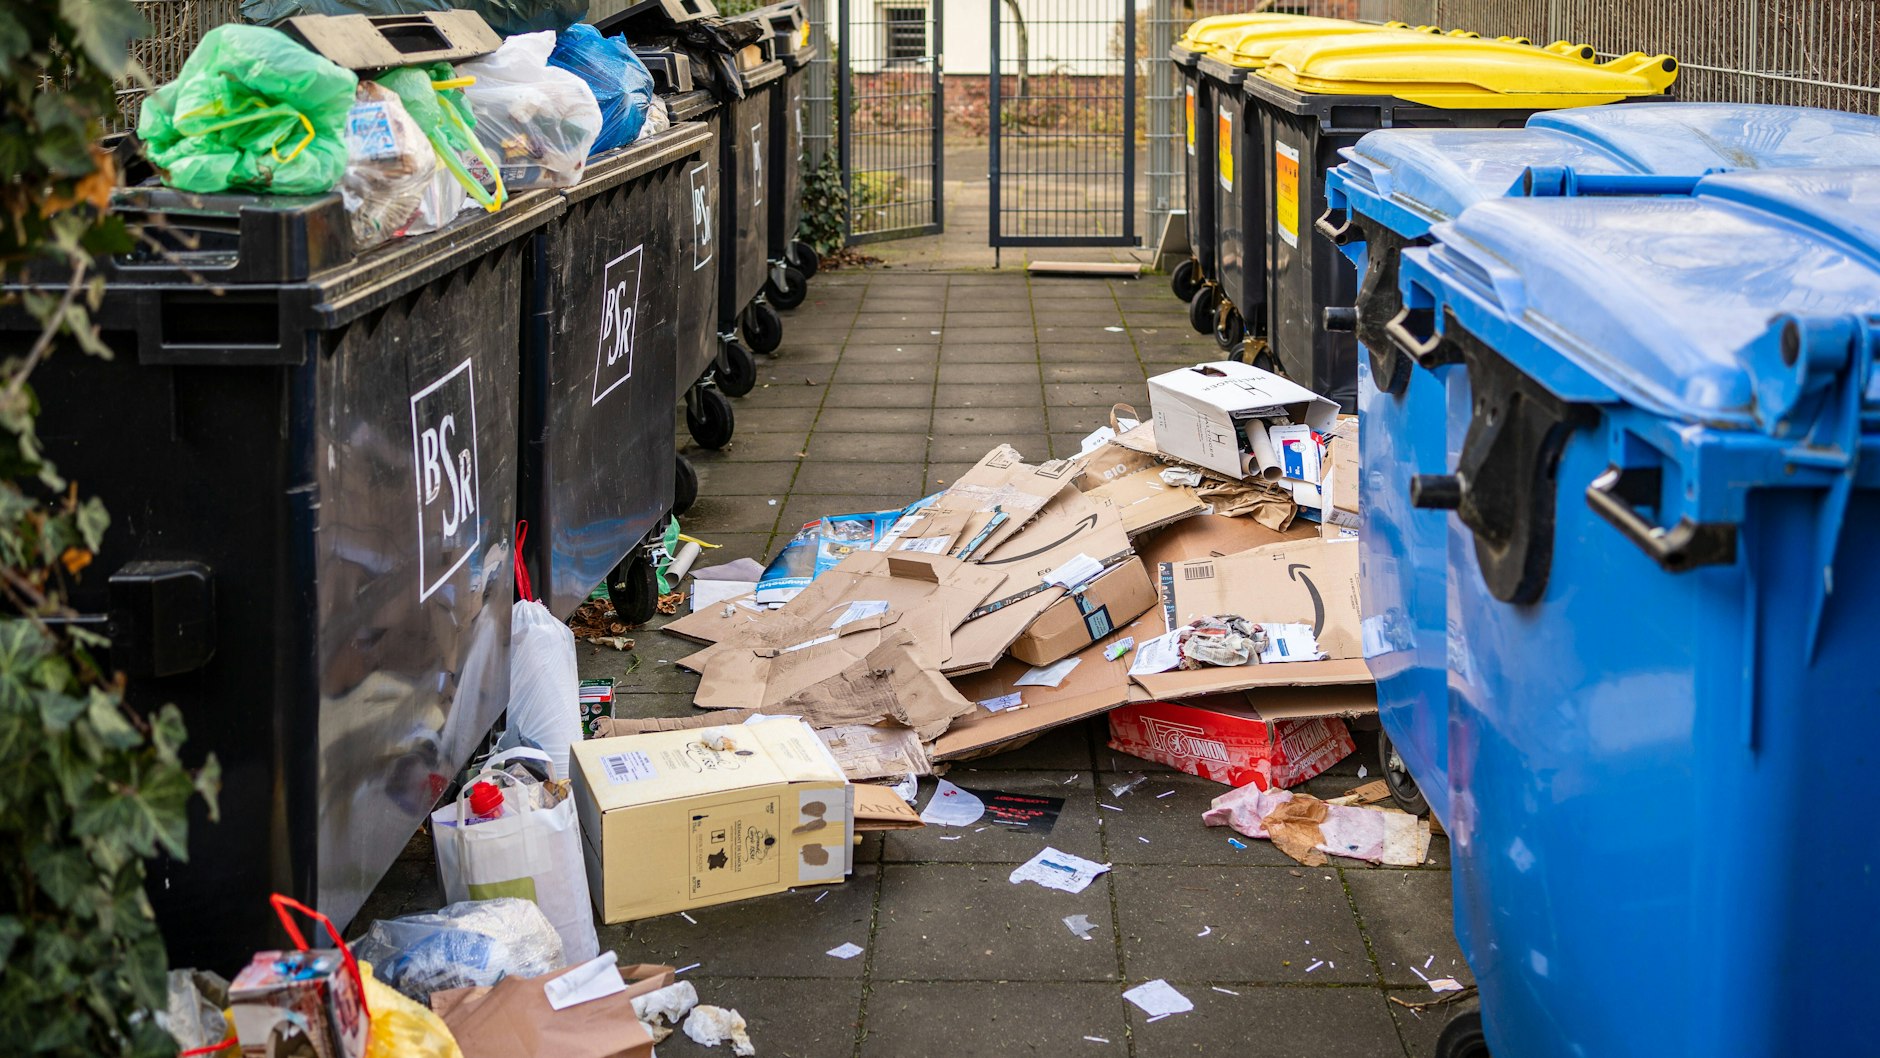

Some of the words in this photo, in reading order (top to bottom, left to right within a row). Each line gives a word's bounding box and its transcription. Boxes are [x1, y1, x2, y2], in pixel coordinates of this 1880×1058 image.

[694, 185, 711, 246] BSR
[602, 279, 632, 368] BSR
[421, 412, 475, 541] BSR
[758, 579, 811, 589] playmobil
[1188, 737, 1228, 762] UNION
